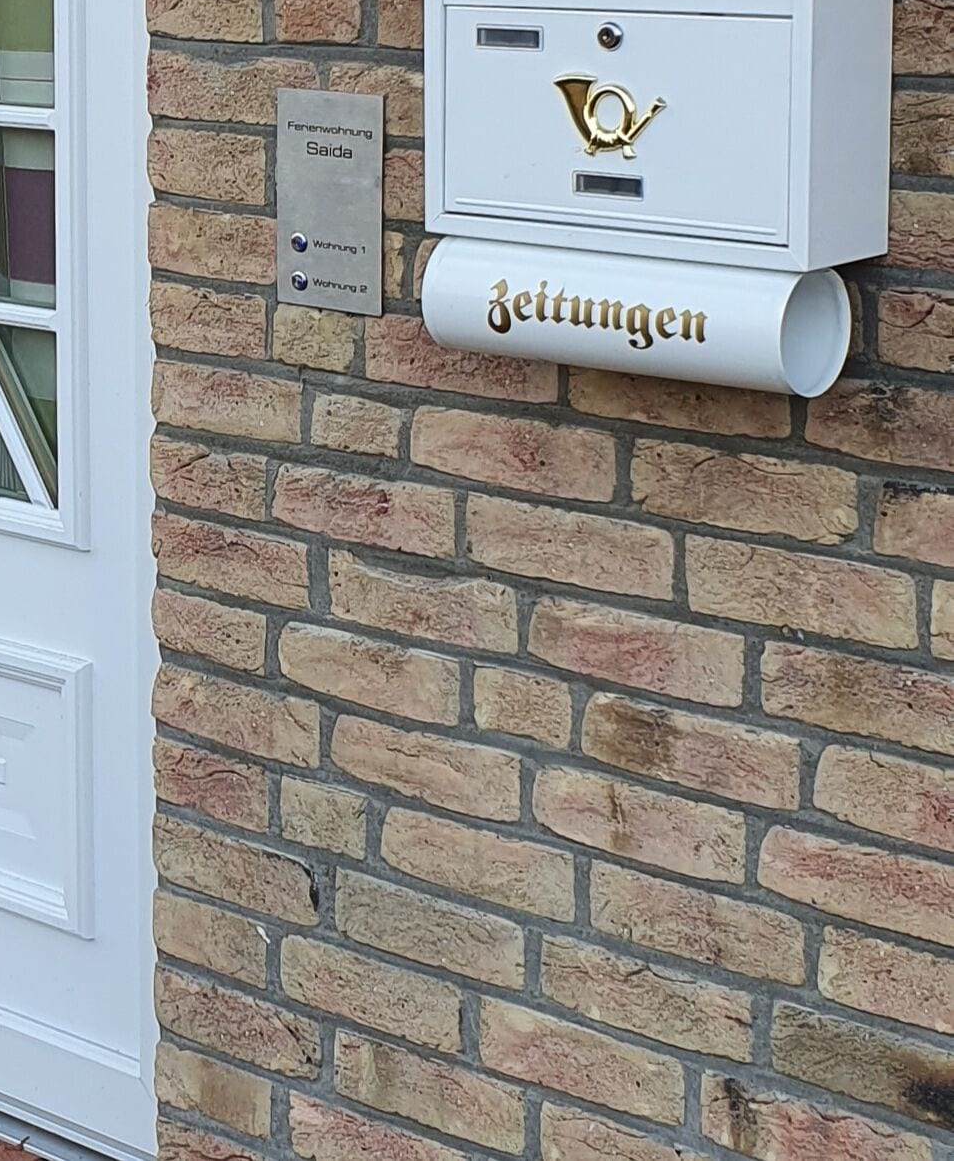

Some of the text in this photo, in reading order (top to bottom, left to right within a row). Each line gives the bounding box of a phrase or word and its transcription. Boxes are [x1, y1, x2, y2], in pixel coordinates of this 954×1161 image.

[287, 120, 373, 140] Ferienwohnung
[306, 141, 353, 159] Saida
[312, 239, 366, 255] Wohnung 1
[312, 277, 368, 294] Wohnung 2
[486, 278, 709, 350] Zeitungen
